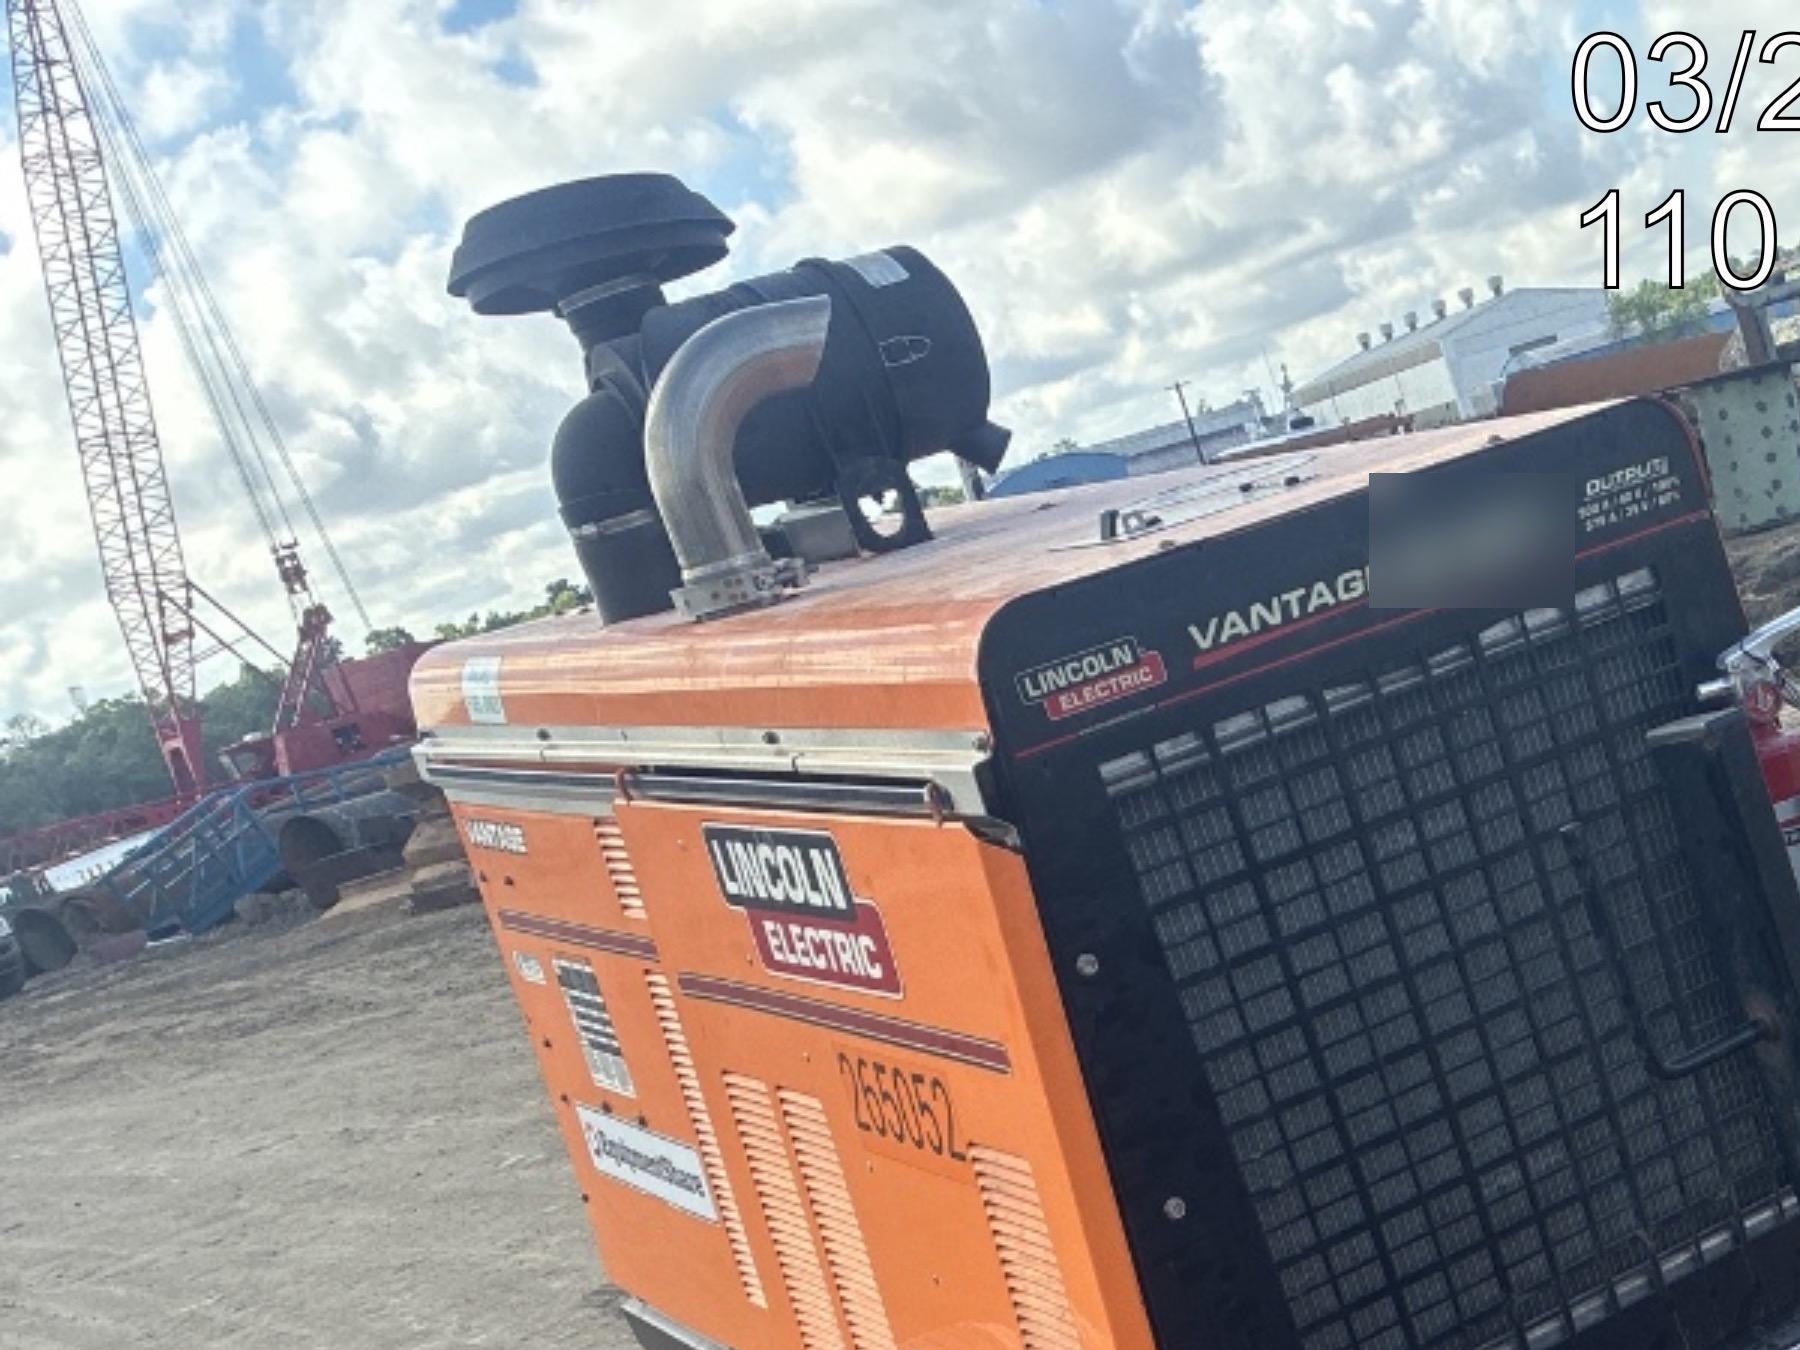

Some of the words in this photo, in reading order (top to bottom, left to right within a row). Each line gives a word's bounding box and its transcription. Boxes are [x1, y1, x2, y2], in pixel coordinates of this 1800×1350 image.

[1188, 565, 1369, 650] VANTAG
[1024, 644, 1133, 698] LINCOLN
[1058, 668, 1153, 711] ELECTRIC
[711, 838, 848, 911] LINCOLN
[762, 919, 884, 980] ELECTRIC
[837, 1051, 967, 1162] 265052
